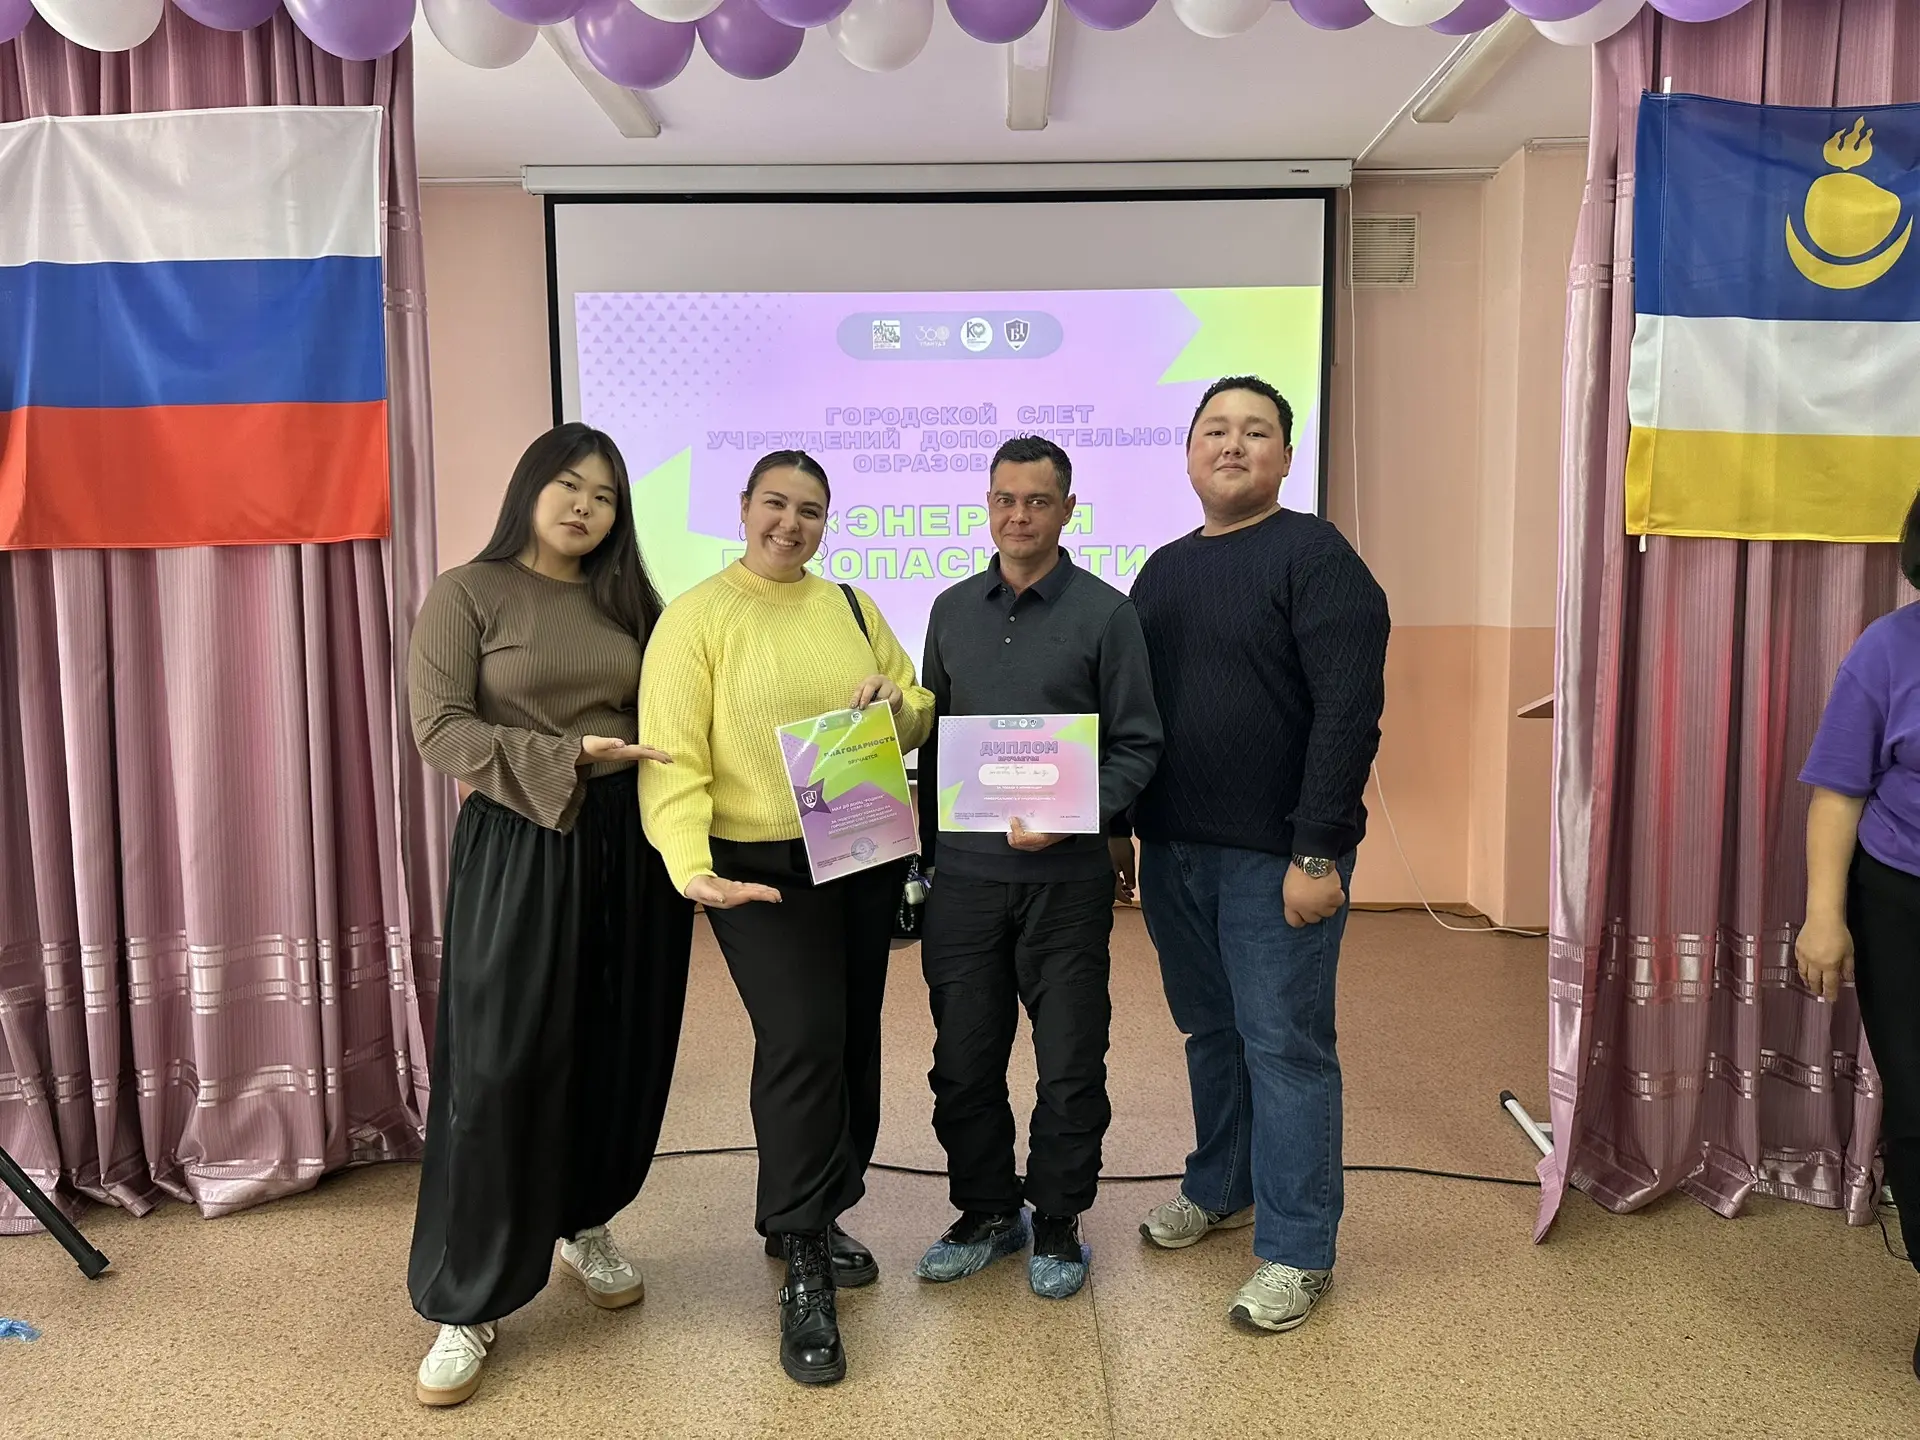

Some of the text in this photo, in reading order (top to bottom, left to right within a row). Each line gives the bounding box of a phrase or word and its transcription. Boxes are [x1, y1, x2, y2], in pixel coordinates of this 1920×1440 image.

[825, 402, 1095, 428] ГОРОДСКОЙ СЛЕТ
[707, 427, 1189, 452] УЧРЕЖДЕНИЙ ДОПОЛИТЕЛЬНОГ
[853, 453, 988, 473] ОБРАЗОВ
[827, 503, 1093, 537] «ЭНЕРЯ
[980, 741, 1058, 756] ДИПЛОМ
